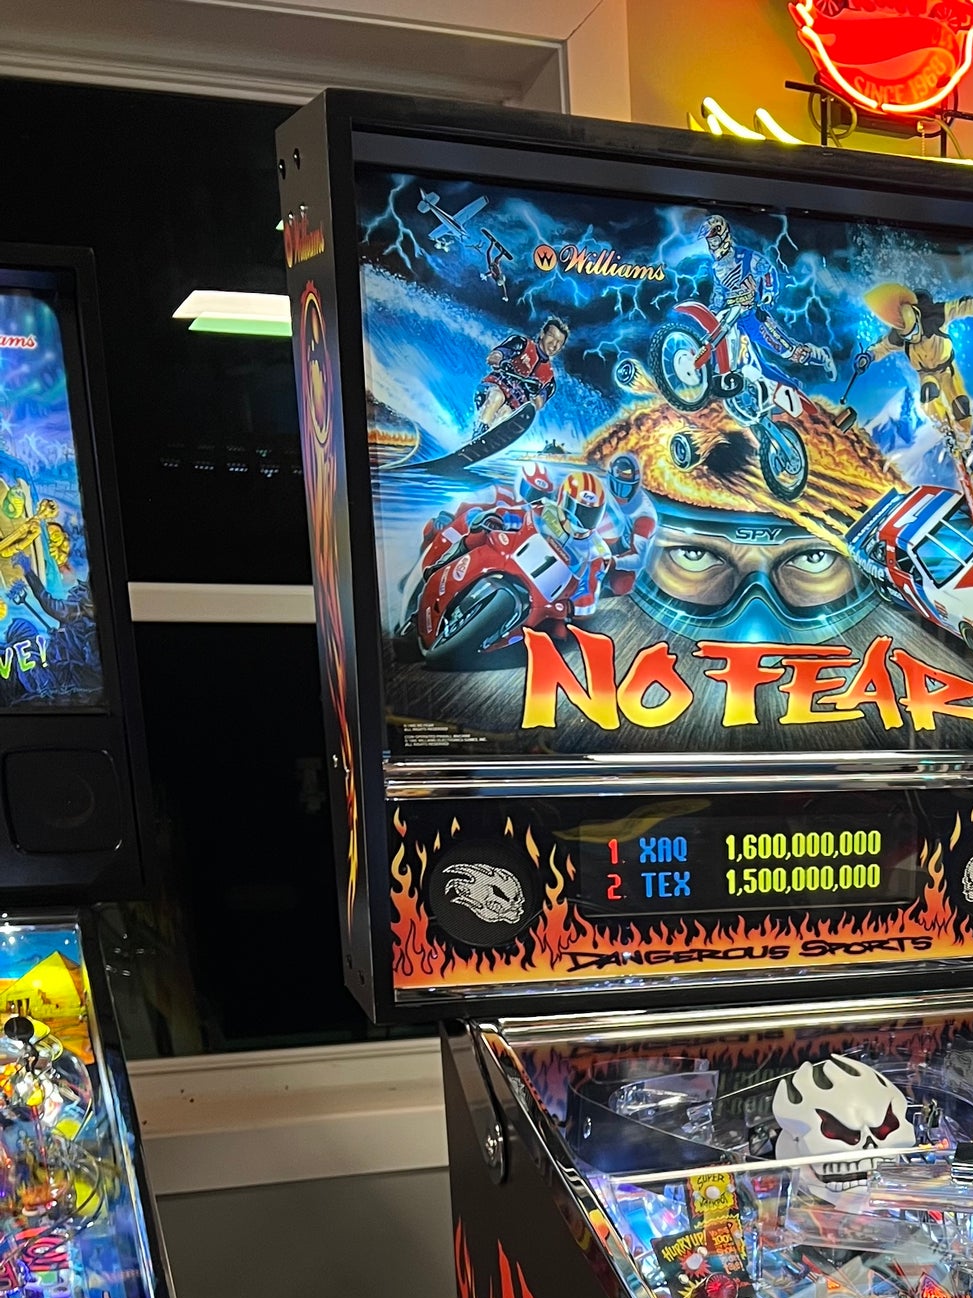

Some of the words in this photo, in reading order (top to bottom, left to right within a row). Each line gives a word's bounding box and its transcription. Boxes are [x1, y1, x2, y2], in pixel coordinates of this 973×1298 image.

[854, 76, 905, 103] SINCE
[908, 56, 946, 101] 1968
[559, 245, 665, 281] Williams
[735, 527, 782, 541] SPY
[521, 623, 694, 731] NO
[639, 836, 688, 863] XAQ
[725, 830, 881, 862] 1,600,000,000
[641, 871, 691, 898] TEX
[725, 864, 881, 896] 1,500,000,000
[561, 944, 790, 972] DANGEROUS
[798, 937, 934, 957] SPORTS
[661, 1233, 692, 1262] HURRY
[691, 1230, 707, 1247] UP!
